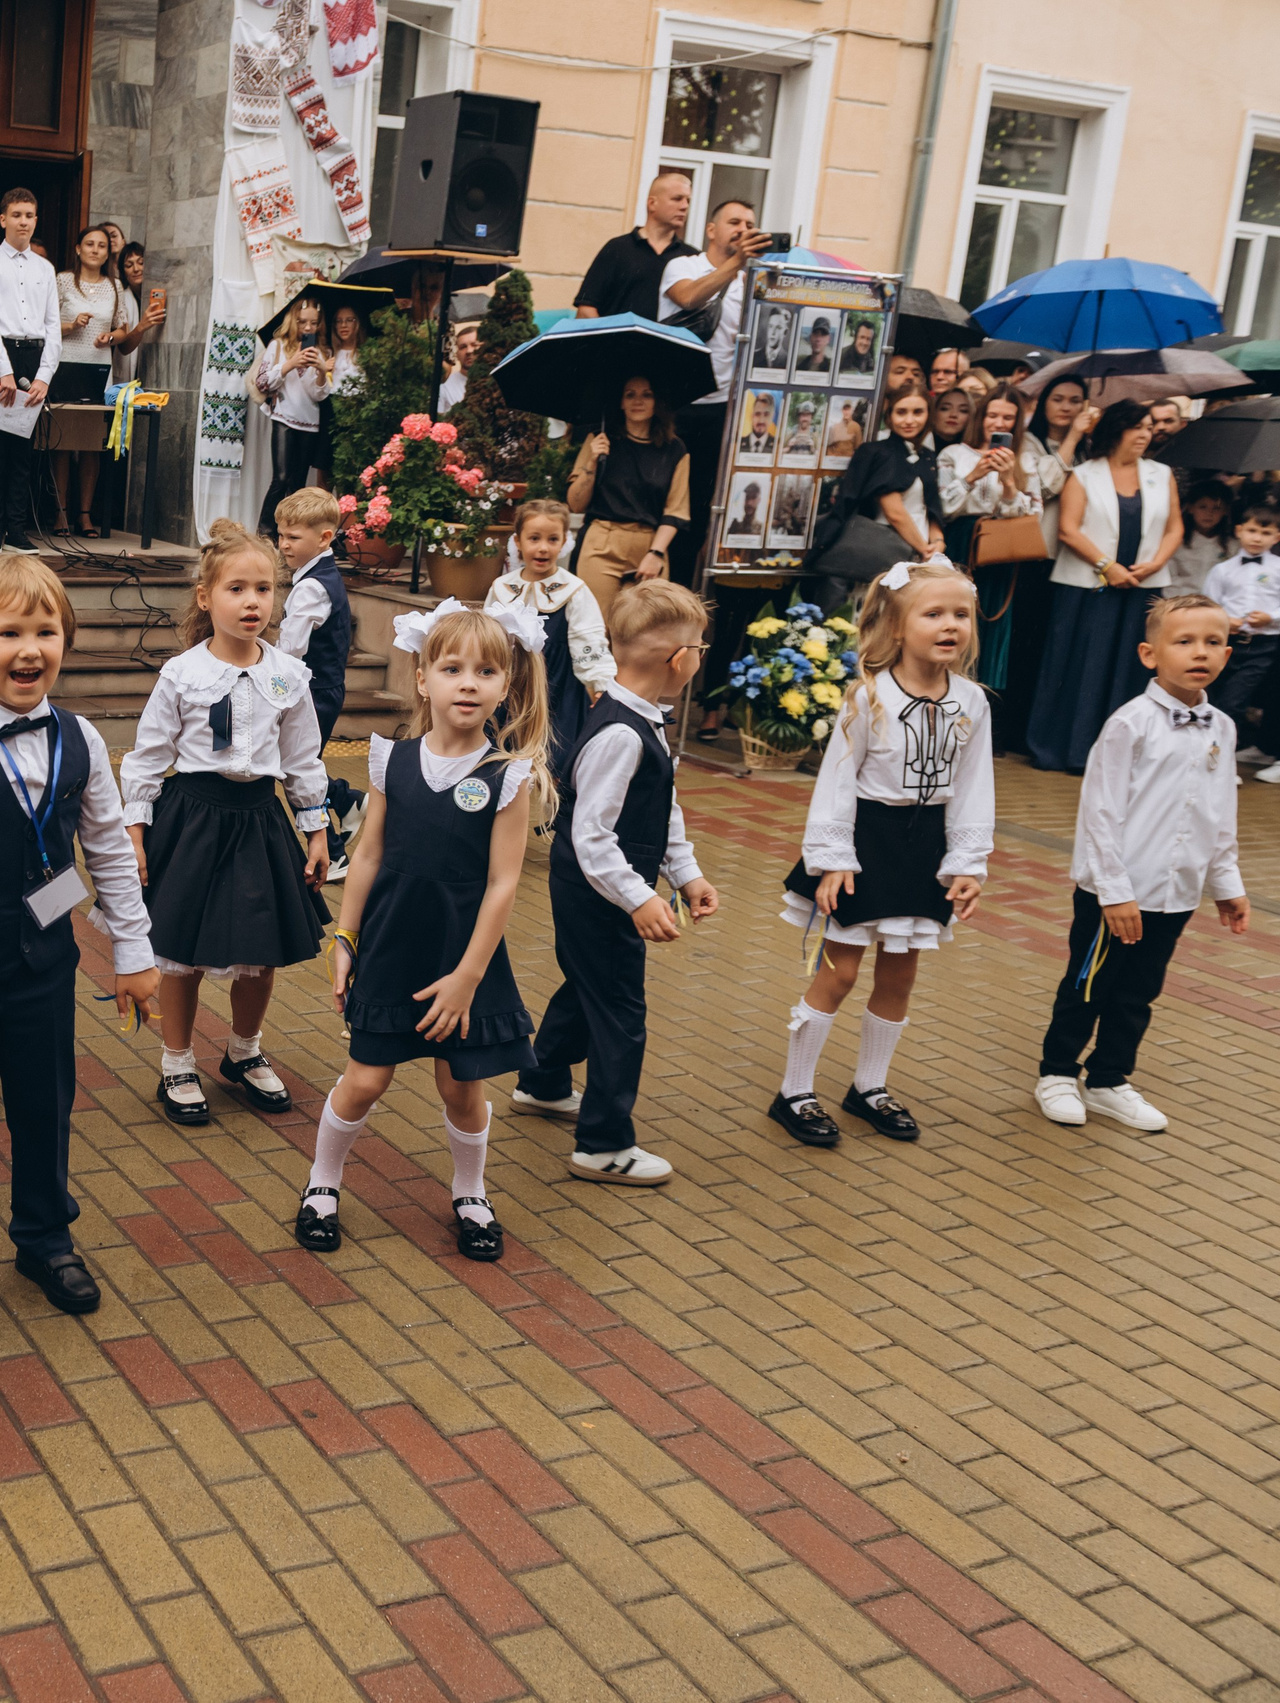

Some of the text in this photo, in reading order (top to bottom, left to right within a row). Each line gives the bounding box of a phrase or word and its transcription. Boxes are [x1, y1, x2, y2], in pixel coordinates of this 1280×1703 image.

[776, 275, 805, 287] ГЕРОЇ
[805, 278, 819, 290] НЕ
[764, 288, 788, 299] ДОКИ
[859, 297, 881, 308] ЖИВА
